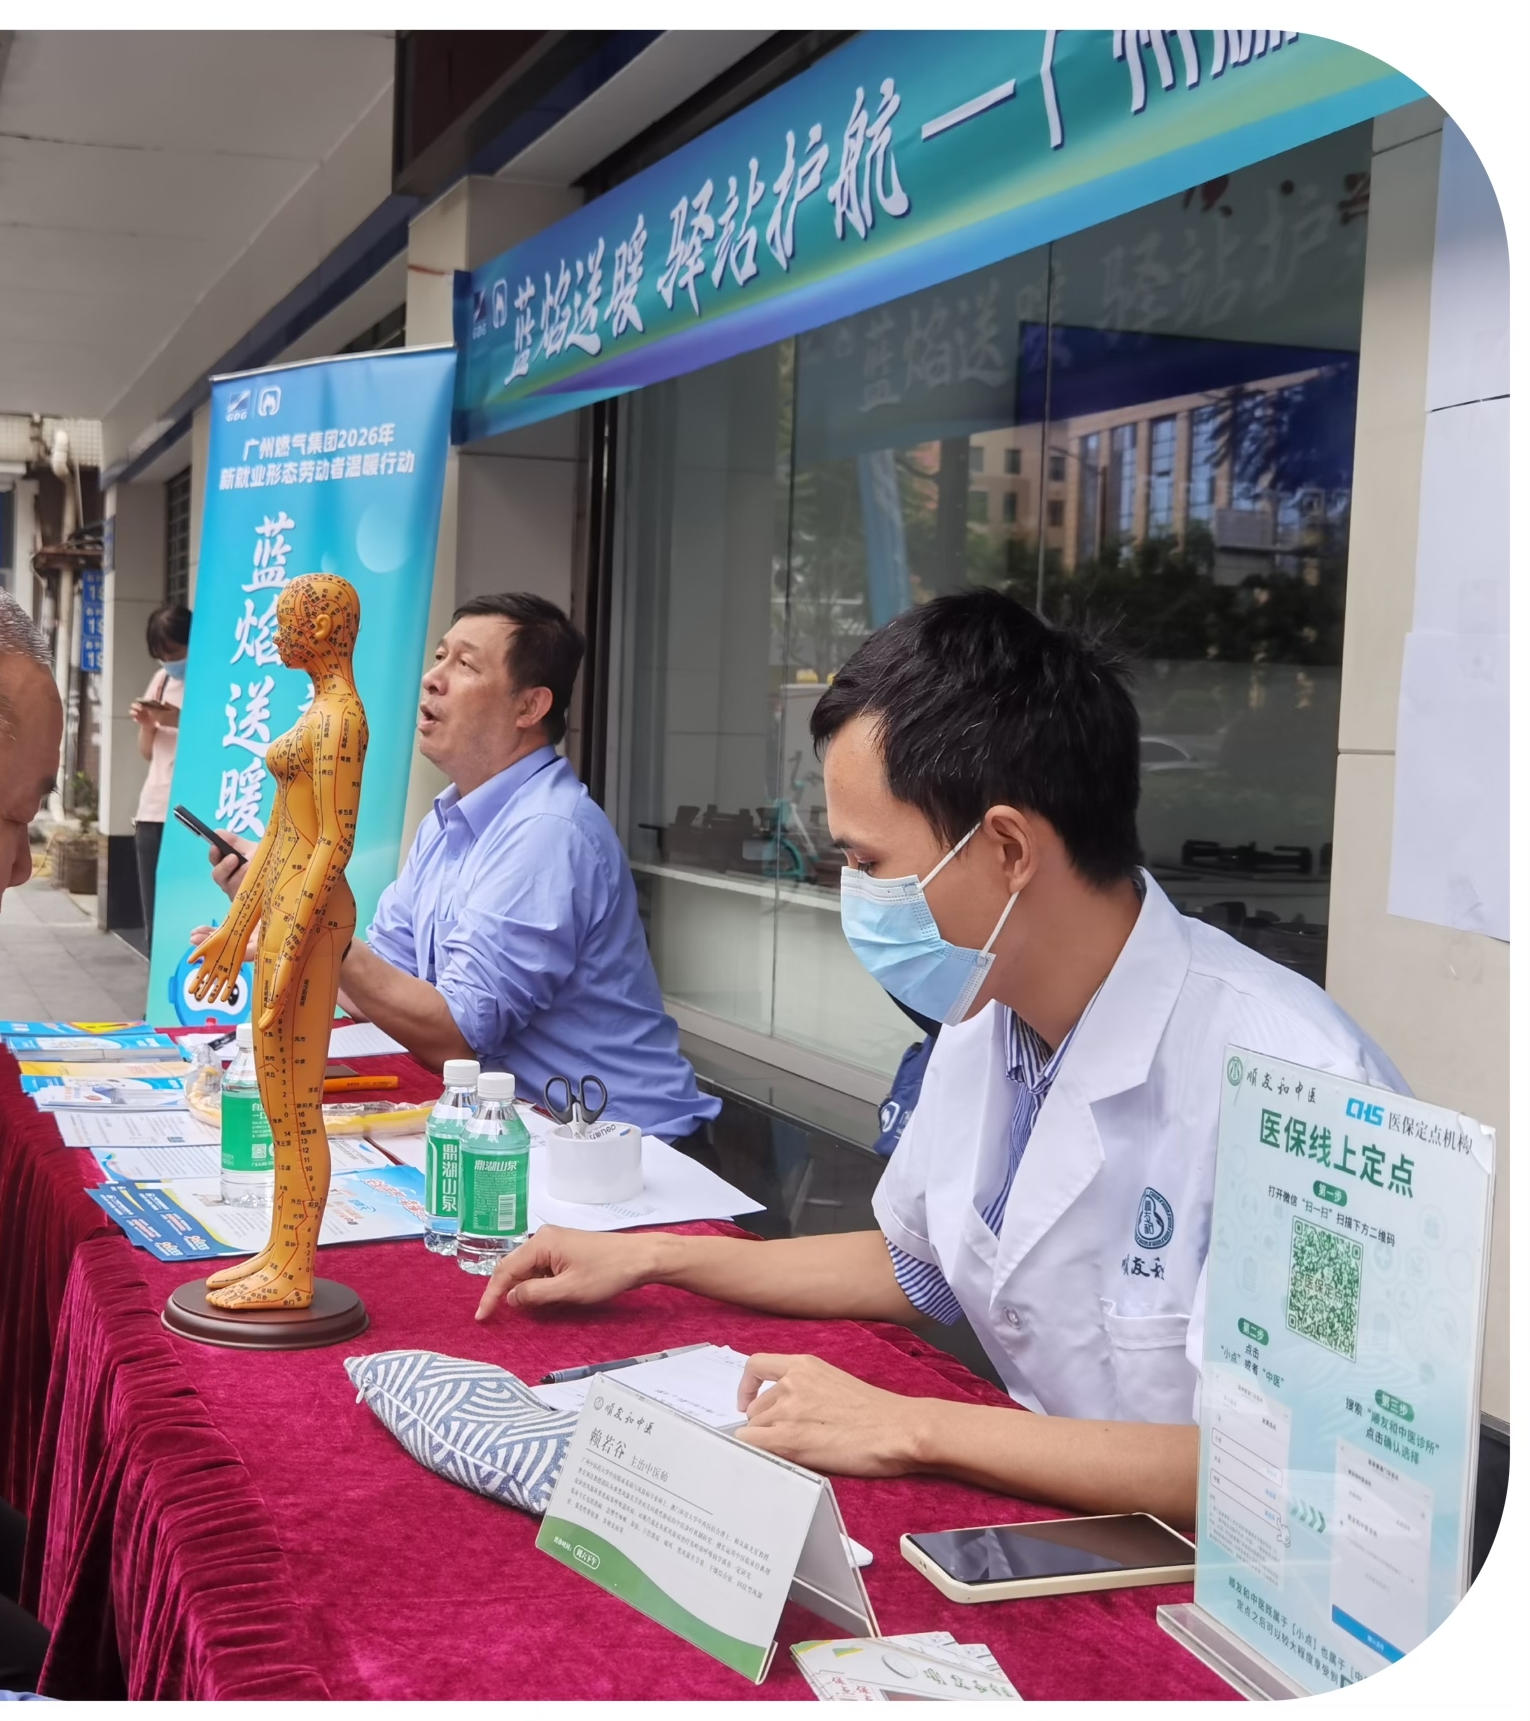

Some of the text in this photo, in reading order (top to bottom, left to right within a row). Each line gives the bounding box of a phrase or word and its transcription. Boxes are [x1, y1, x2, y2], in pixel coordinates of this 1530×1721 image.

[503, 212, 649, 387] 蓝焰送暖
[656, 75, 910, 319] 驿站护航
[225, 410, 248, 422] GDG
[242, 422, 396, 462] 广州燃气集团2026年
[218, 449, 416, 491] 新就业形态劳动者温暖行动
[215, 510, 296, 839] 蓝焰送暖
[1345, 1097, 1385, 1127] CHS
[1388, 1111, 1474, 1156] 医保定点机构
[474, 1159, 517, 1172] 鼎湖山泉
[1259, 1107, 1415, 1200] 医保线上定点
[441, 1143, 458, 1212] 鼎湖山泉
[1318, 1182, 1343, 1204] 第一步
[1242, 1320, 1265, 1342] 第二步
[1244, 1342, 1260, 1360] 点击
[1380, 1393, 1409, 1417] 第三步
[588, 1426, 669, 1483] 赖若谷 主治中医师
[1365, 1426, 1420, 1465] 点击确认选择
